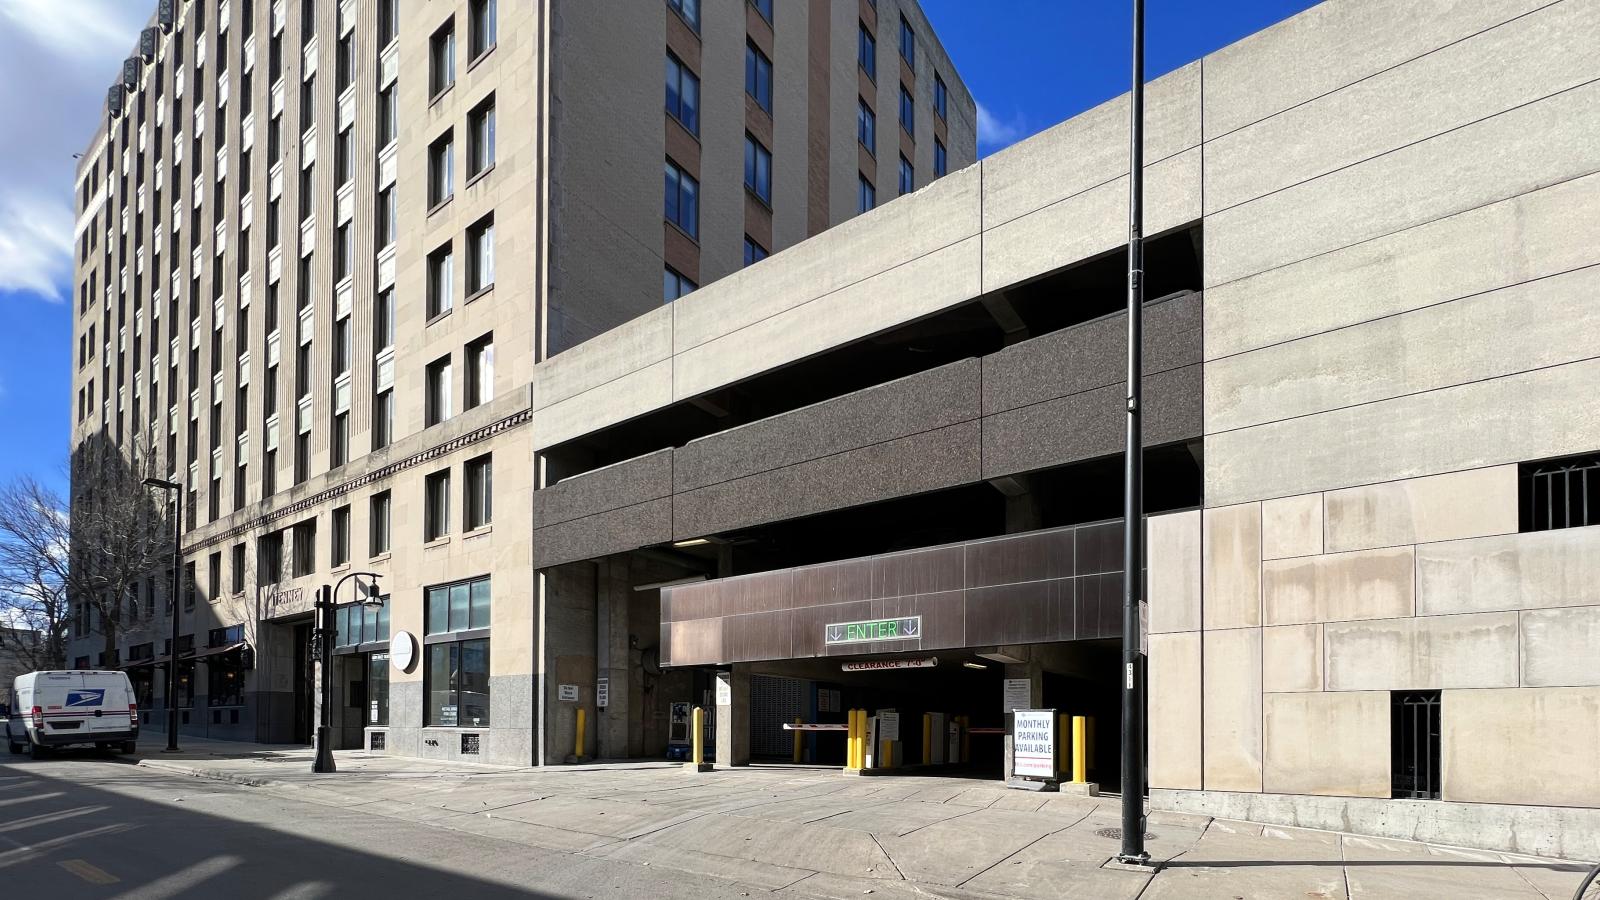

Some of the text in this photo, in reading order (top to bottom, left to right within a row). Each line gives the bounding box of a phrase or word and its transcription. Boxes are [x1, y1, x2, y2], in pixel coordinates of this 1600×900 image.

[847, 621, 898, 640] ENTER
[847, 660, 901, 670] CLEARANCE
[1016, 719, 1050, 729] MONTHLY
[1018, 731, 1049, 741] PARKING
[1015, 743, 1052, 754] AVAILABLE
